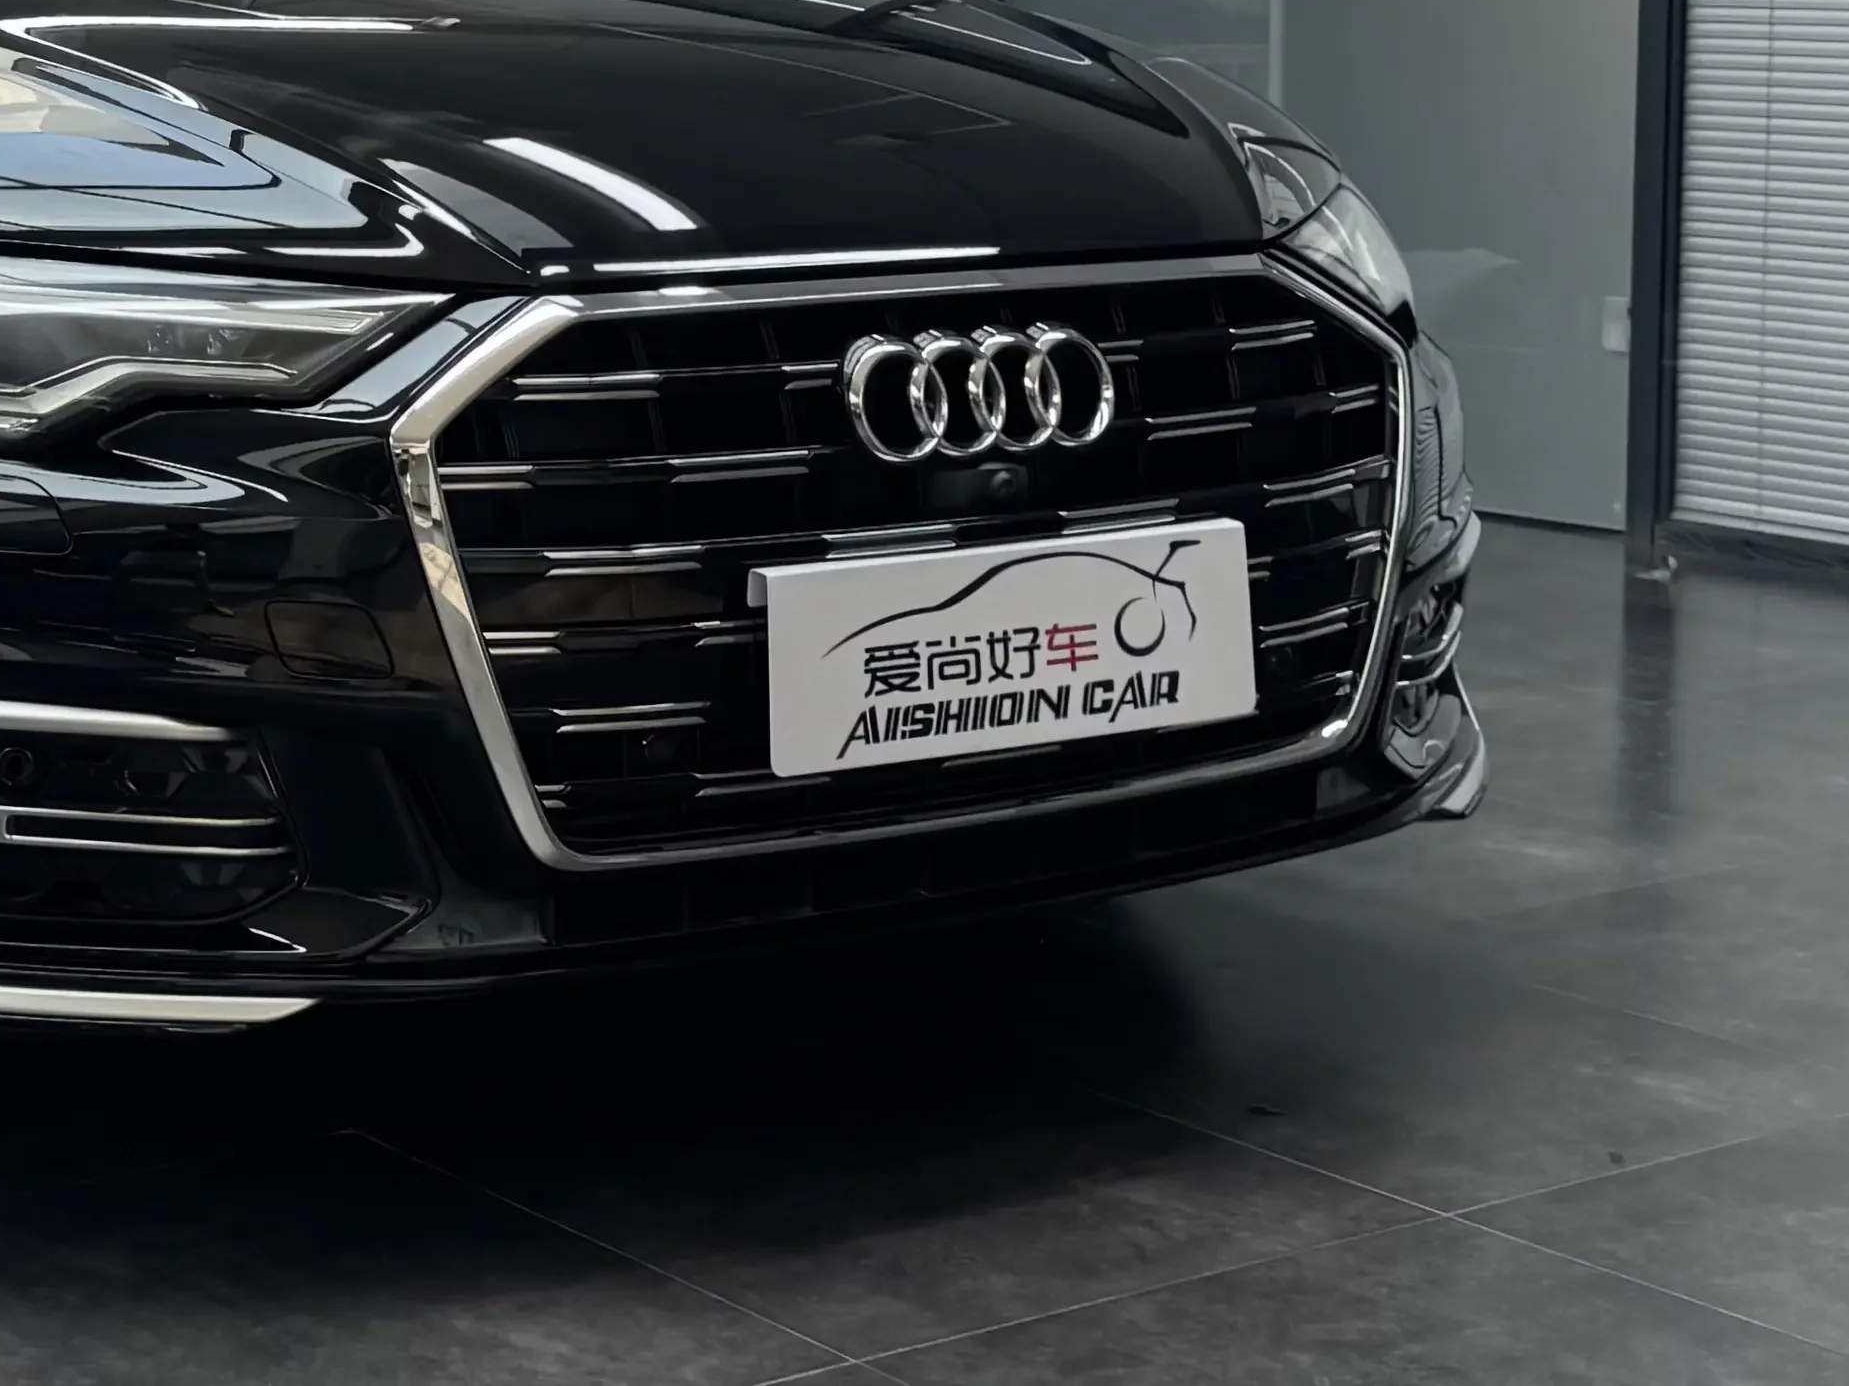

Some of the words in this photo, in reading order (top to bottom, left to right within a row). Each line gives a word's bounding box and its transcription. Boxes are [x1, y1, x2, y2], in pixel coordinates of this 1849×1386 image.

[863, 622, 1099, 699] 爱尚好车
[1081, 669, 1180, 724] CAR
